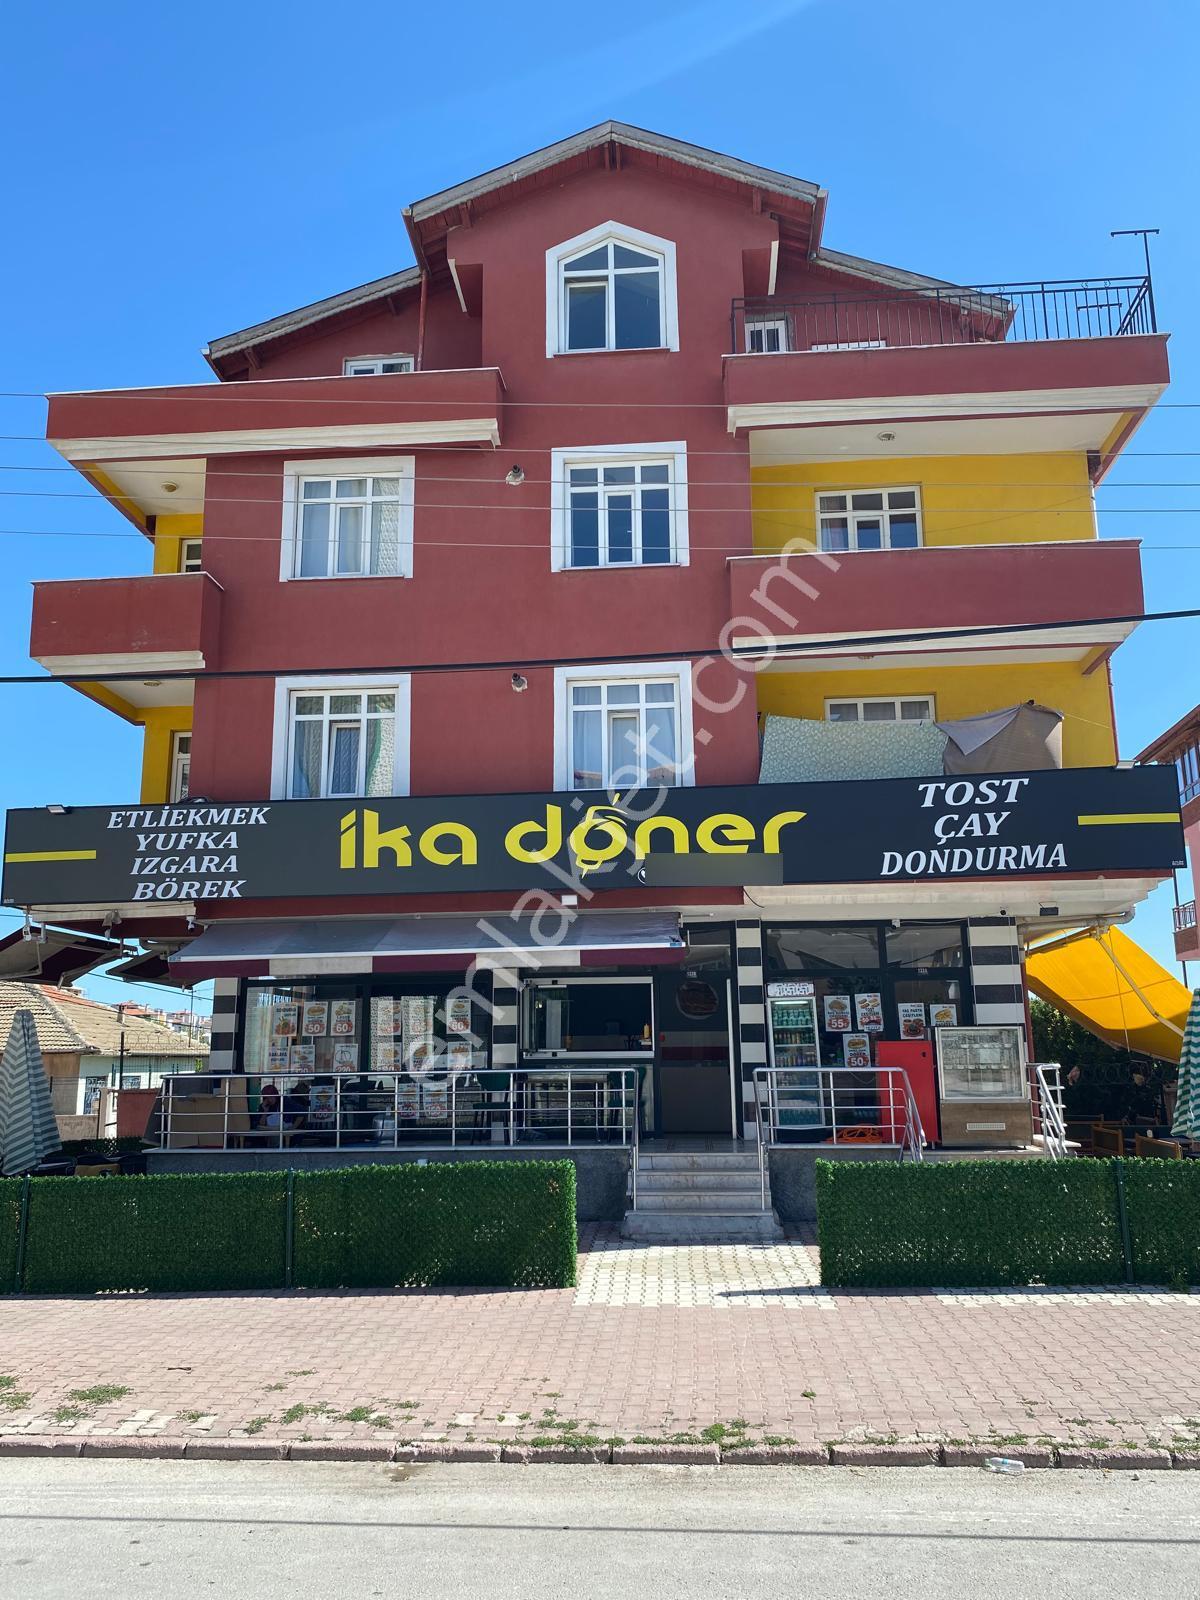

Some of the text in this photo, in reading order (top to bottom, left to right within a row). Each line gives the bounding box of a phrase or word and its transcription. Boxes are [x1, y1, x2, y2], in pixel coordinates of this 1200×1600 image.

[917, 777, 1030, 808] TOST
[106, 805, 271, 829] ETLİEKMEK
[933, 811, 1011, 845] ÇAY
[136, 831, 239, 852] YUFKA
[130, 855, 239, 876] IZGARA
[879, 843, 1068, 876] DONDURMA
[131, 878, 248, 900] BÖREK
[336, 1023, 349, 1032] 60
